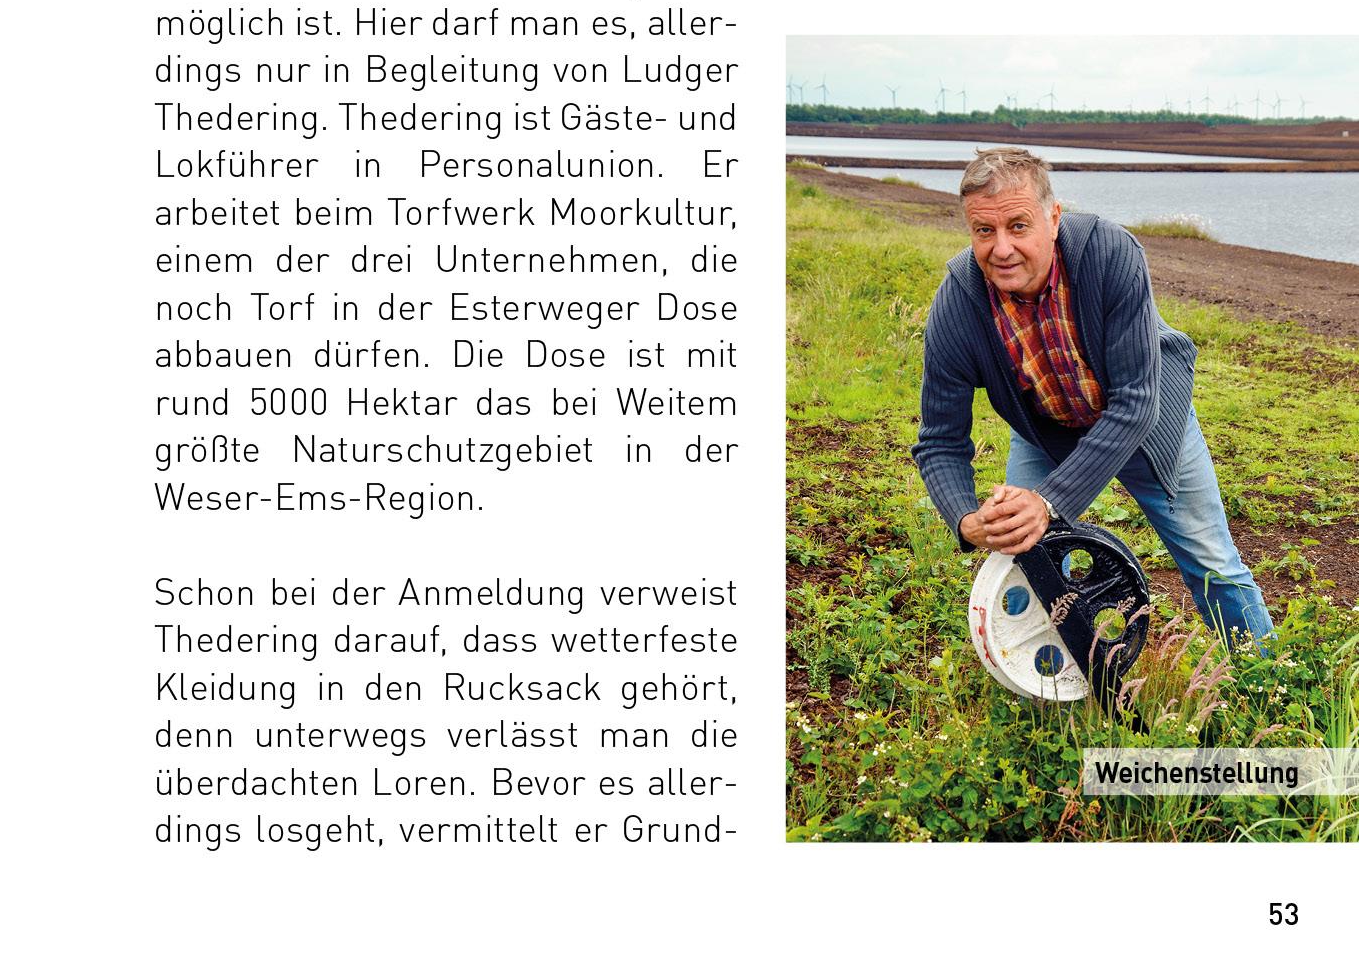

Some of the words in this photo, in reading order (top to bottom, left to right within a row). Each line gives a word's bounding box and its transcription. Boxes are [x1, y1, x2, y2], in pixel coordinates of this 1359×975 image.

[155, 103, 326, 139] Thedering.
[339, 103, 500, 139] Thedering
[515, 103, 550, 130] ist
[562, 103, 666, 130] Gäste-
[680, 103, 734, 130] und
[156, 198, 279, 225] arbeitet
[297, 198, 371, 225] beim
[388, 198, 535, 225] Torfwerk
[552, 198, 735, 230] Moorkultur,
[157, 245, 251, 272] einem
[277, 245, 329, 272] der
[352, 245, 410, 272] drei
[438, 245, 666, 277] Unternehmen,
[692, 245, 737, 272] die
[156, 435, 259, 471] größte
[295, 435, 592, 471] Naturschutzgebiet
[627, 435, 650, 462] in
[686, 435, 738, 462] der
[155, 483, 482, 519] Weser-Ems-Region.
[155, 578, 252, 605] Schon
[273, 578, 314, 605] bei
[333, 578, 385, 605] der
[398, 578, 582, 614] Anmeldung
[600, 578, 736, 605] verweist
[155, 625, 316, 661] Thedering
[335, 625, 445, 657] darauf,
[464, 625, 536, 652] dass
[551, 625, 737, 652] wetterfeste
[158, 673, 294, 709] Kleidung
[319, 673, 342, 700] in
[366, 673, 420, 700] den
[446, 673, 601, 700] Rucksack
[622, 673, 735, 709] gehört,
[156, 720, 231, 747] denn
[257, 723, 425, 756] unterwegs
[447, 720, 577, 747] verlässt
[602, 729, 667, 747] man
[692, 720, 737, 747] die
[157, 768, 356, 795] überdachten
[375, 768, 474, 795] Loren.
[494, 768, 585, 795] Bevor
[600, 777, 633, 795] es
[649, 768, 736, 795] aller-
[156, 815, 240, 851] dings
[258, 815, 382, 851] losgeht,
[399, 815, 557, 842] vermittelt
[576, 824, 607, 842] er
[624, 815, 736, 842] Grund-
[1270, 903, 1298, 925] 53
